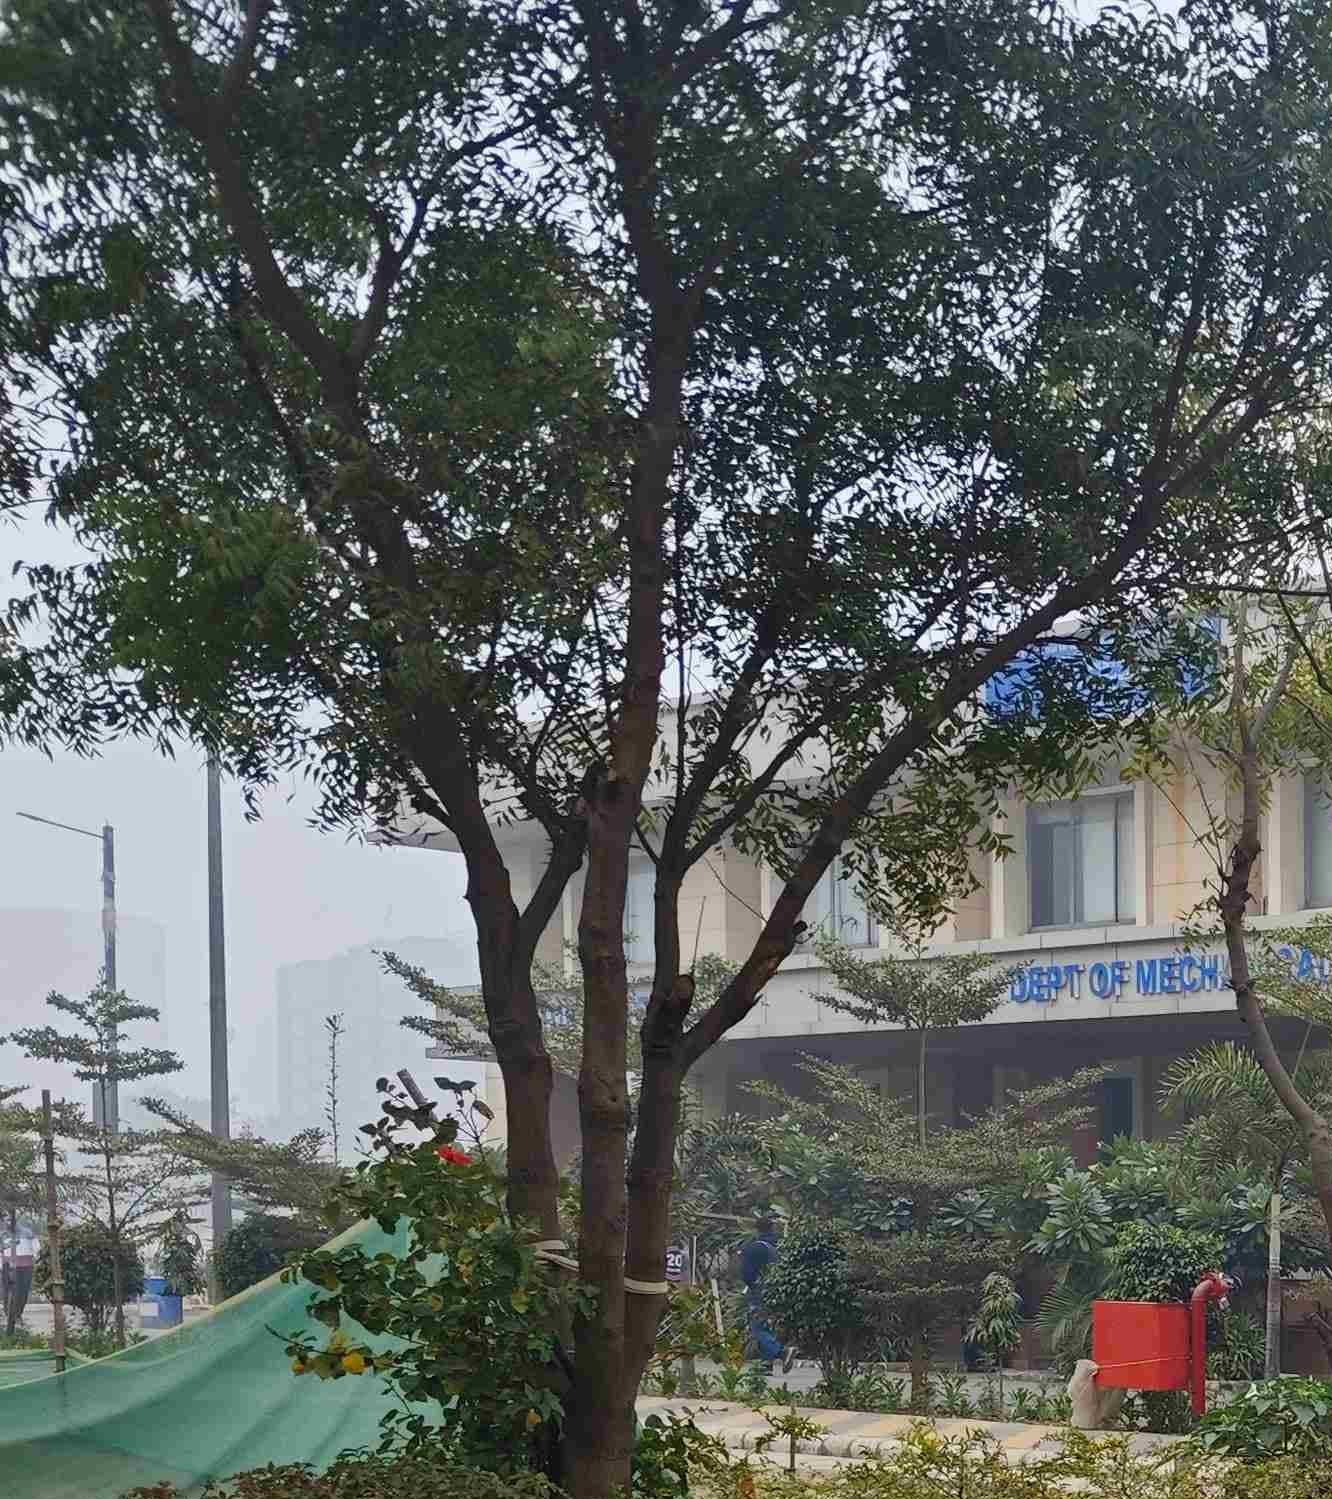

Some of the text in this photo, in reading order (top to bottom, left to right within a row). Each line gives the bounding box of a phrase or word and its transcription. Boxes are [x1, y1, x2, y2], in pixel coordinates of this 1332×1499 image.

[1009, 962, 1084, 1005] DEPT
[1089, 959, 1130, 999] OF
[665, 1253, 682, 1267] 20
